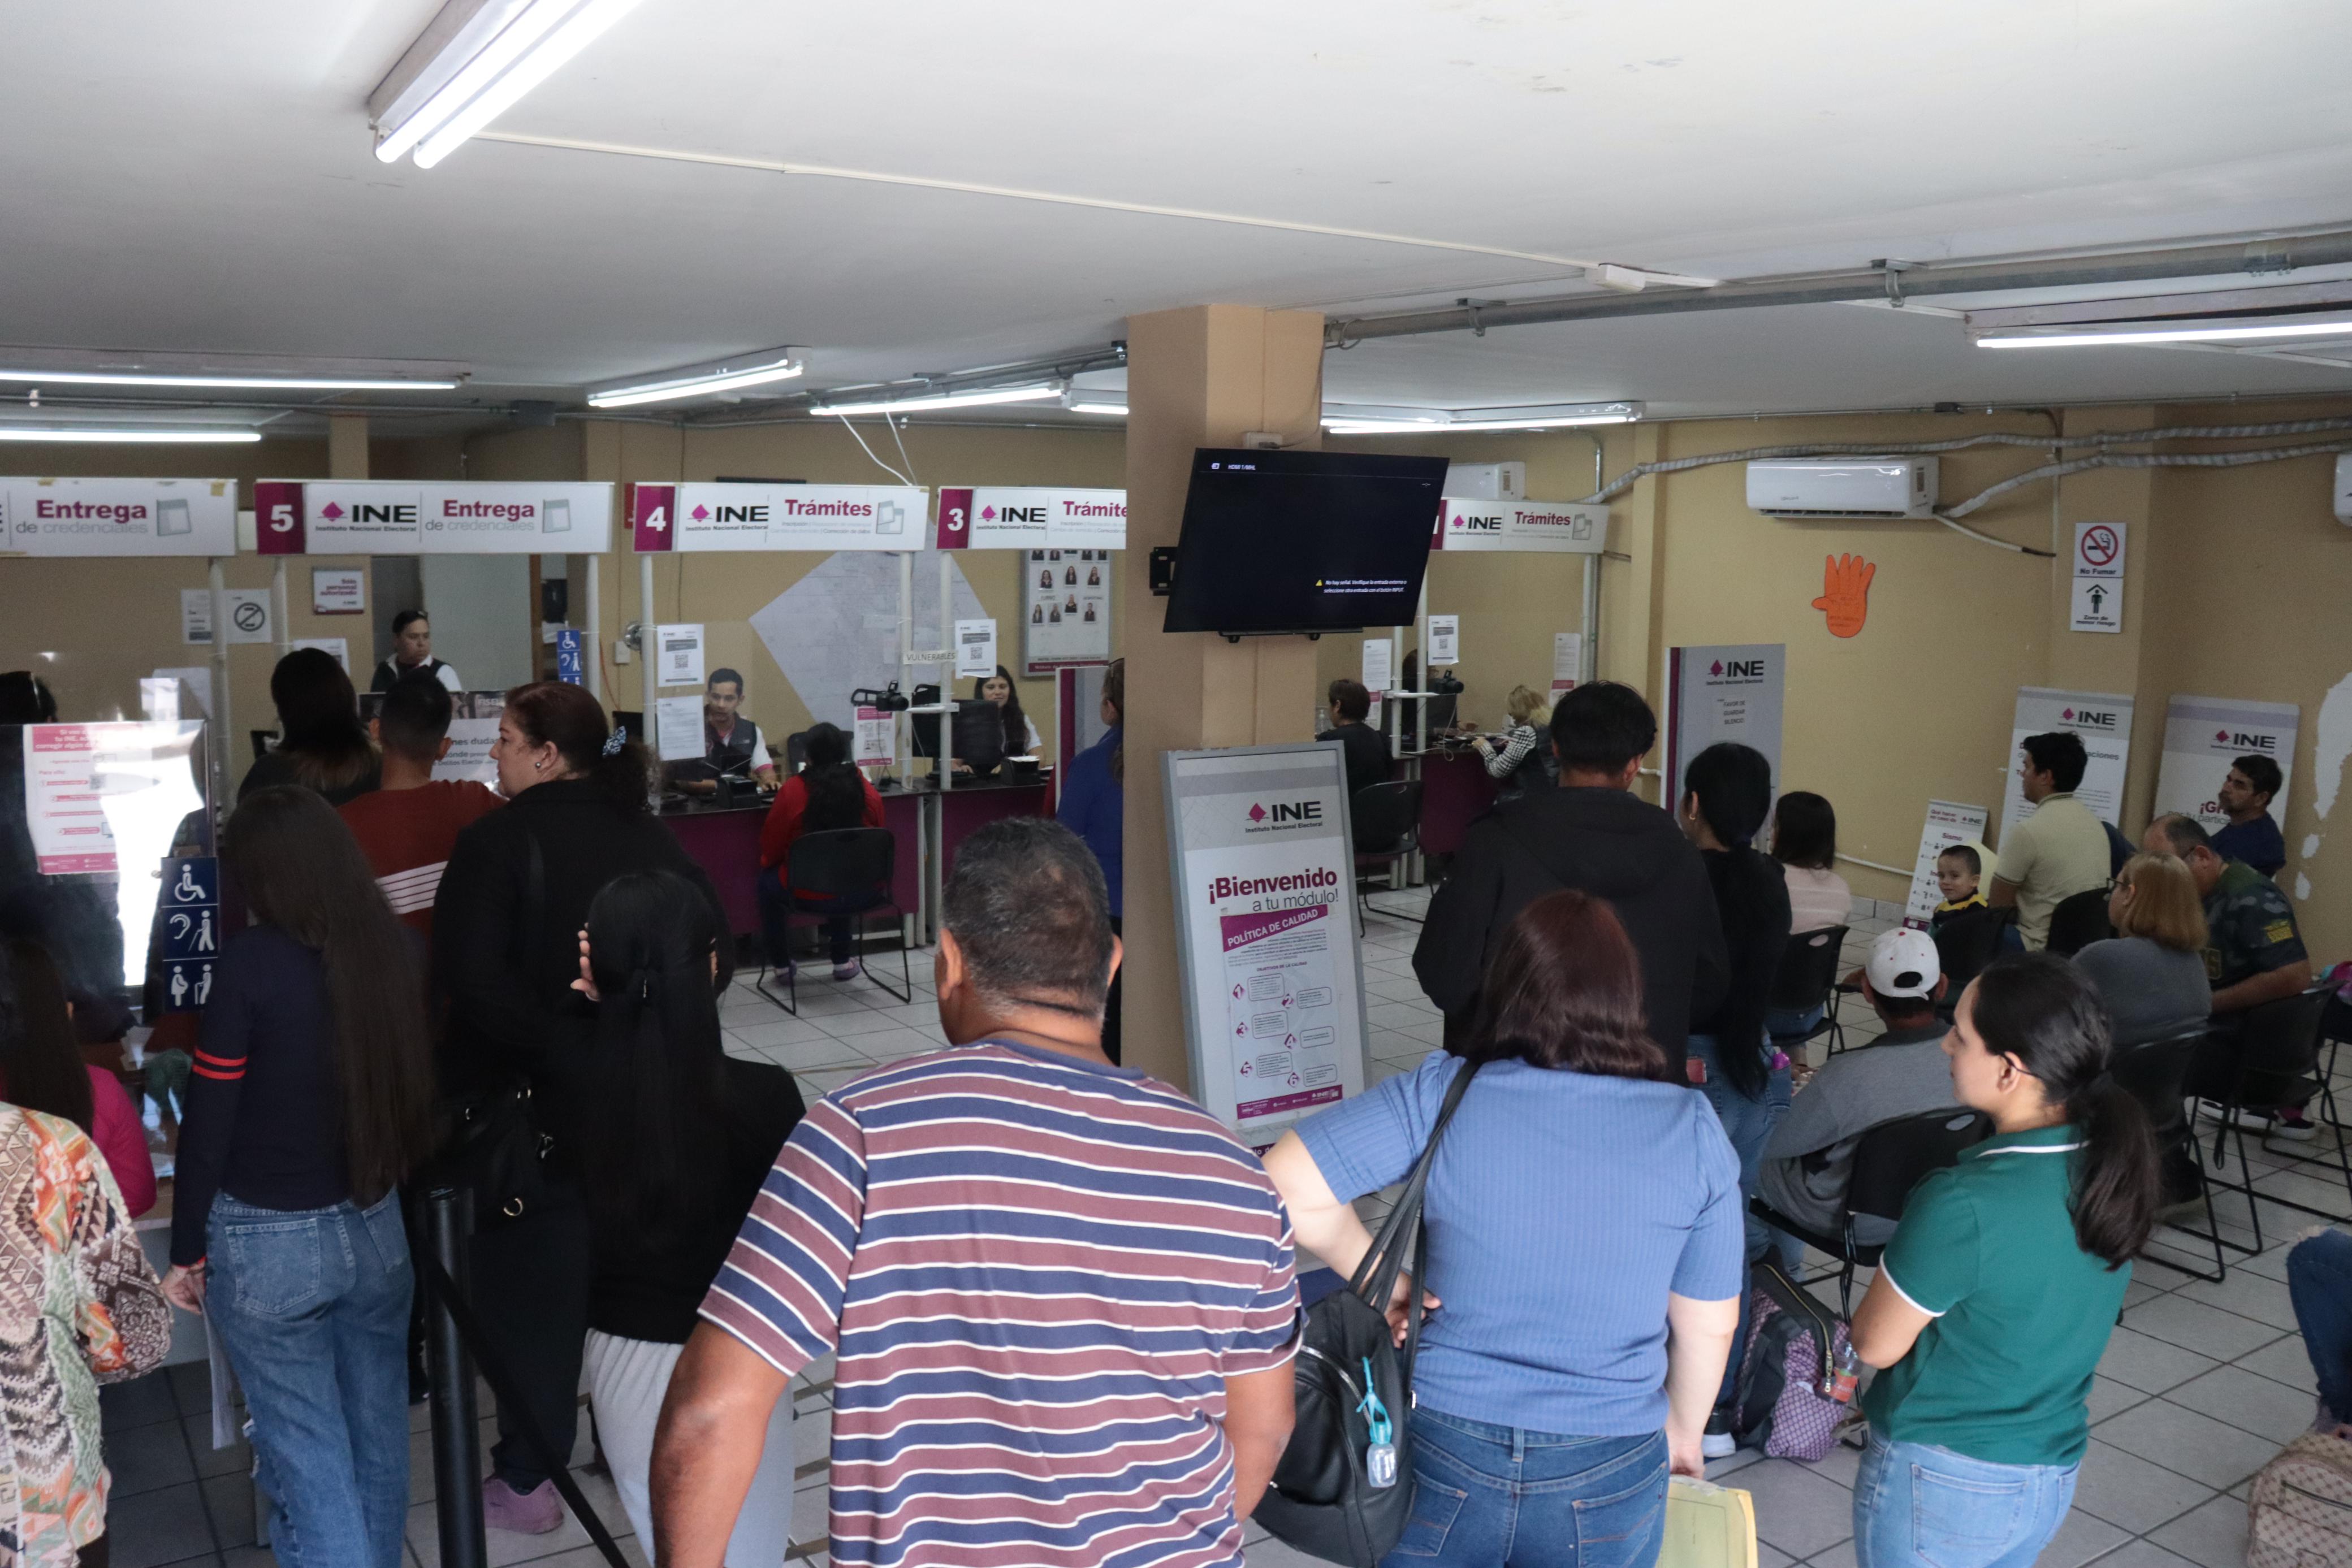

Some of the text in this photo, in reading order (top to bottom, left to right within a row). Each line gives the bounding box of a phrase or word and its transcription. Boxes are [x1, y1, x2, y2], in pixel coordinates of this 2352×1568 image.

[36, 500, 147, 523] Entrega
[352, 505, 416, 523] INE
[443, 500, 534, 521] Entrega
[716, 506, 768, 522] INE
[785, 499, 872, 516] Trámites
[1001, 508, 1046, 522] INE
[1063, 501, 1127, 517] Trámite
[271, 505, 293, 532] 5
[425, 519, 534, 531] de credenciales
[646, 506, 666, 531] 4
[948, 509, 964, 531] 3
[1468, 517, 1502, 530] INE
[1515, 512, 1571, 526] Trámites
[16, 521, 148, 534] de credenciales
[906, 652, 955, 661] VULNERABLES
[1727, 661, 1764, 677] INE
[2078, 711, 2116, 725] INE
[2234, 733, 2276, 748] INE
[1272, 801, 1322, 822] INE
[1942, 833, 1962, 841] Sismo
[1209, 867, 1338, 904] ¡Bienvenido
[1252, 889, 1339, 912] a tu módulo!
[1227, 909, 1318, 947] POLÍTICA DE CALIDAD
